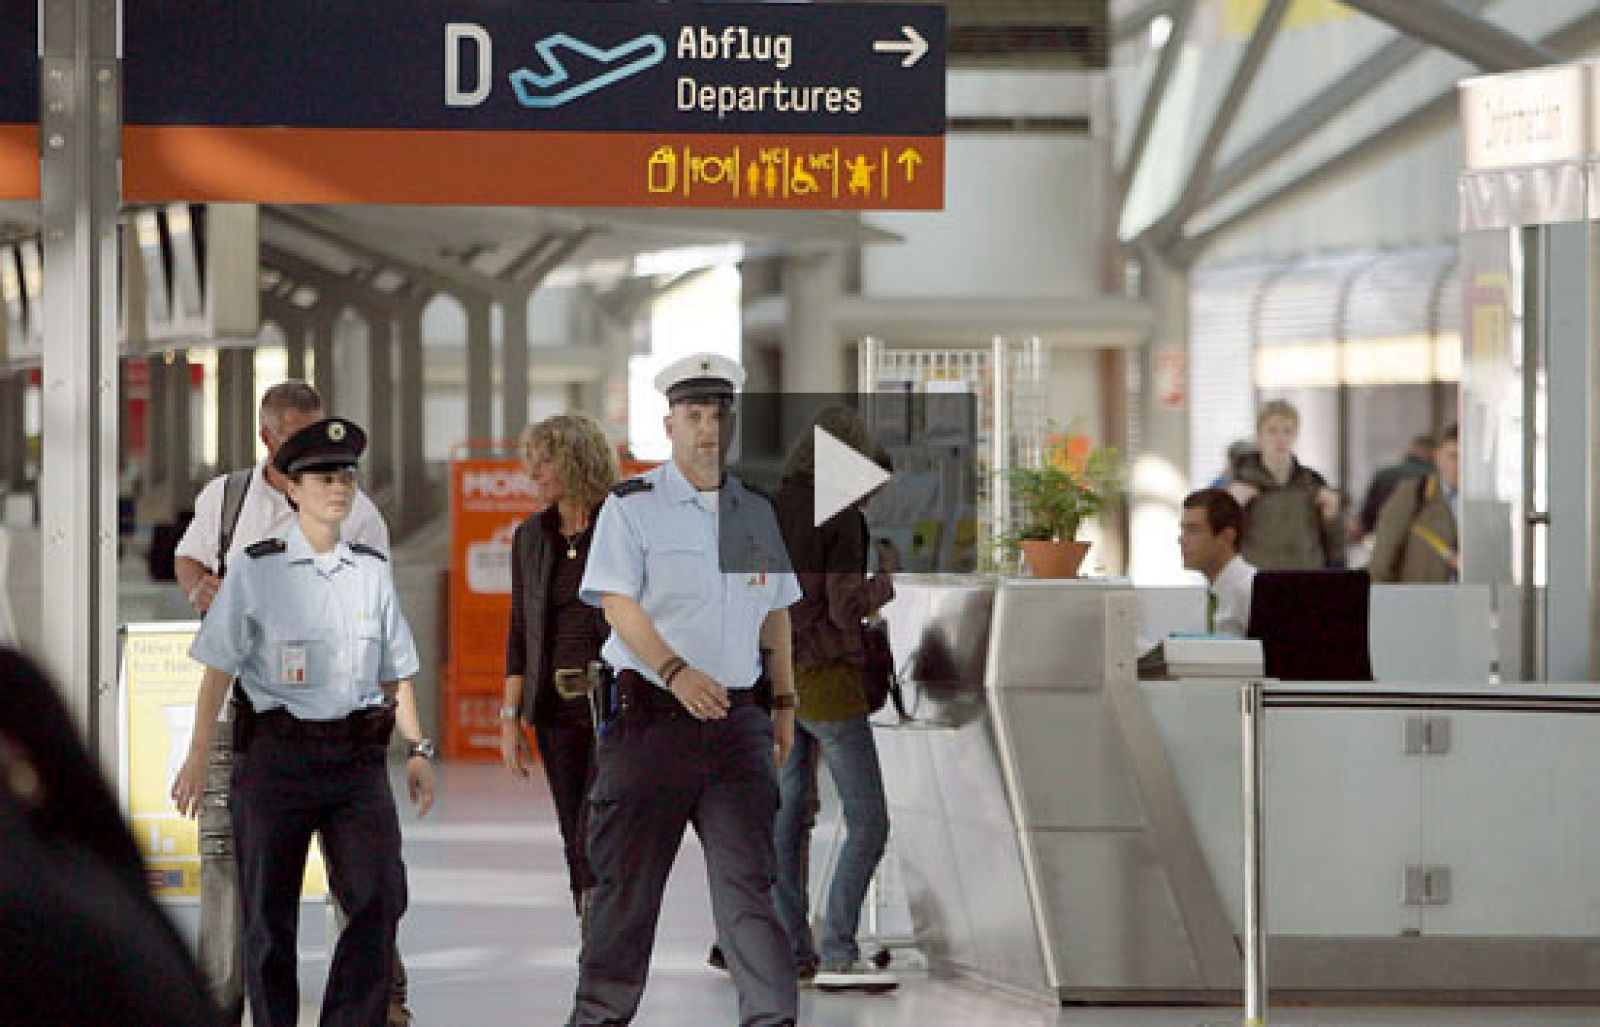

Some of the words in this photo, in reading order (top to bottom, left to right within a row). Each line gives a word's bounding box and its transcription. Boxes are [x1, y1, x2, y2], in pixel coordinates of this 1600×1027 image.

[444, 22, 493, 107] D
[677, 25, 792, 69] Abflug
[677, 77, 863, 119] Departures
